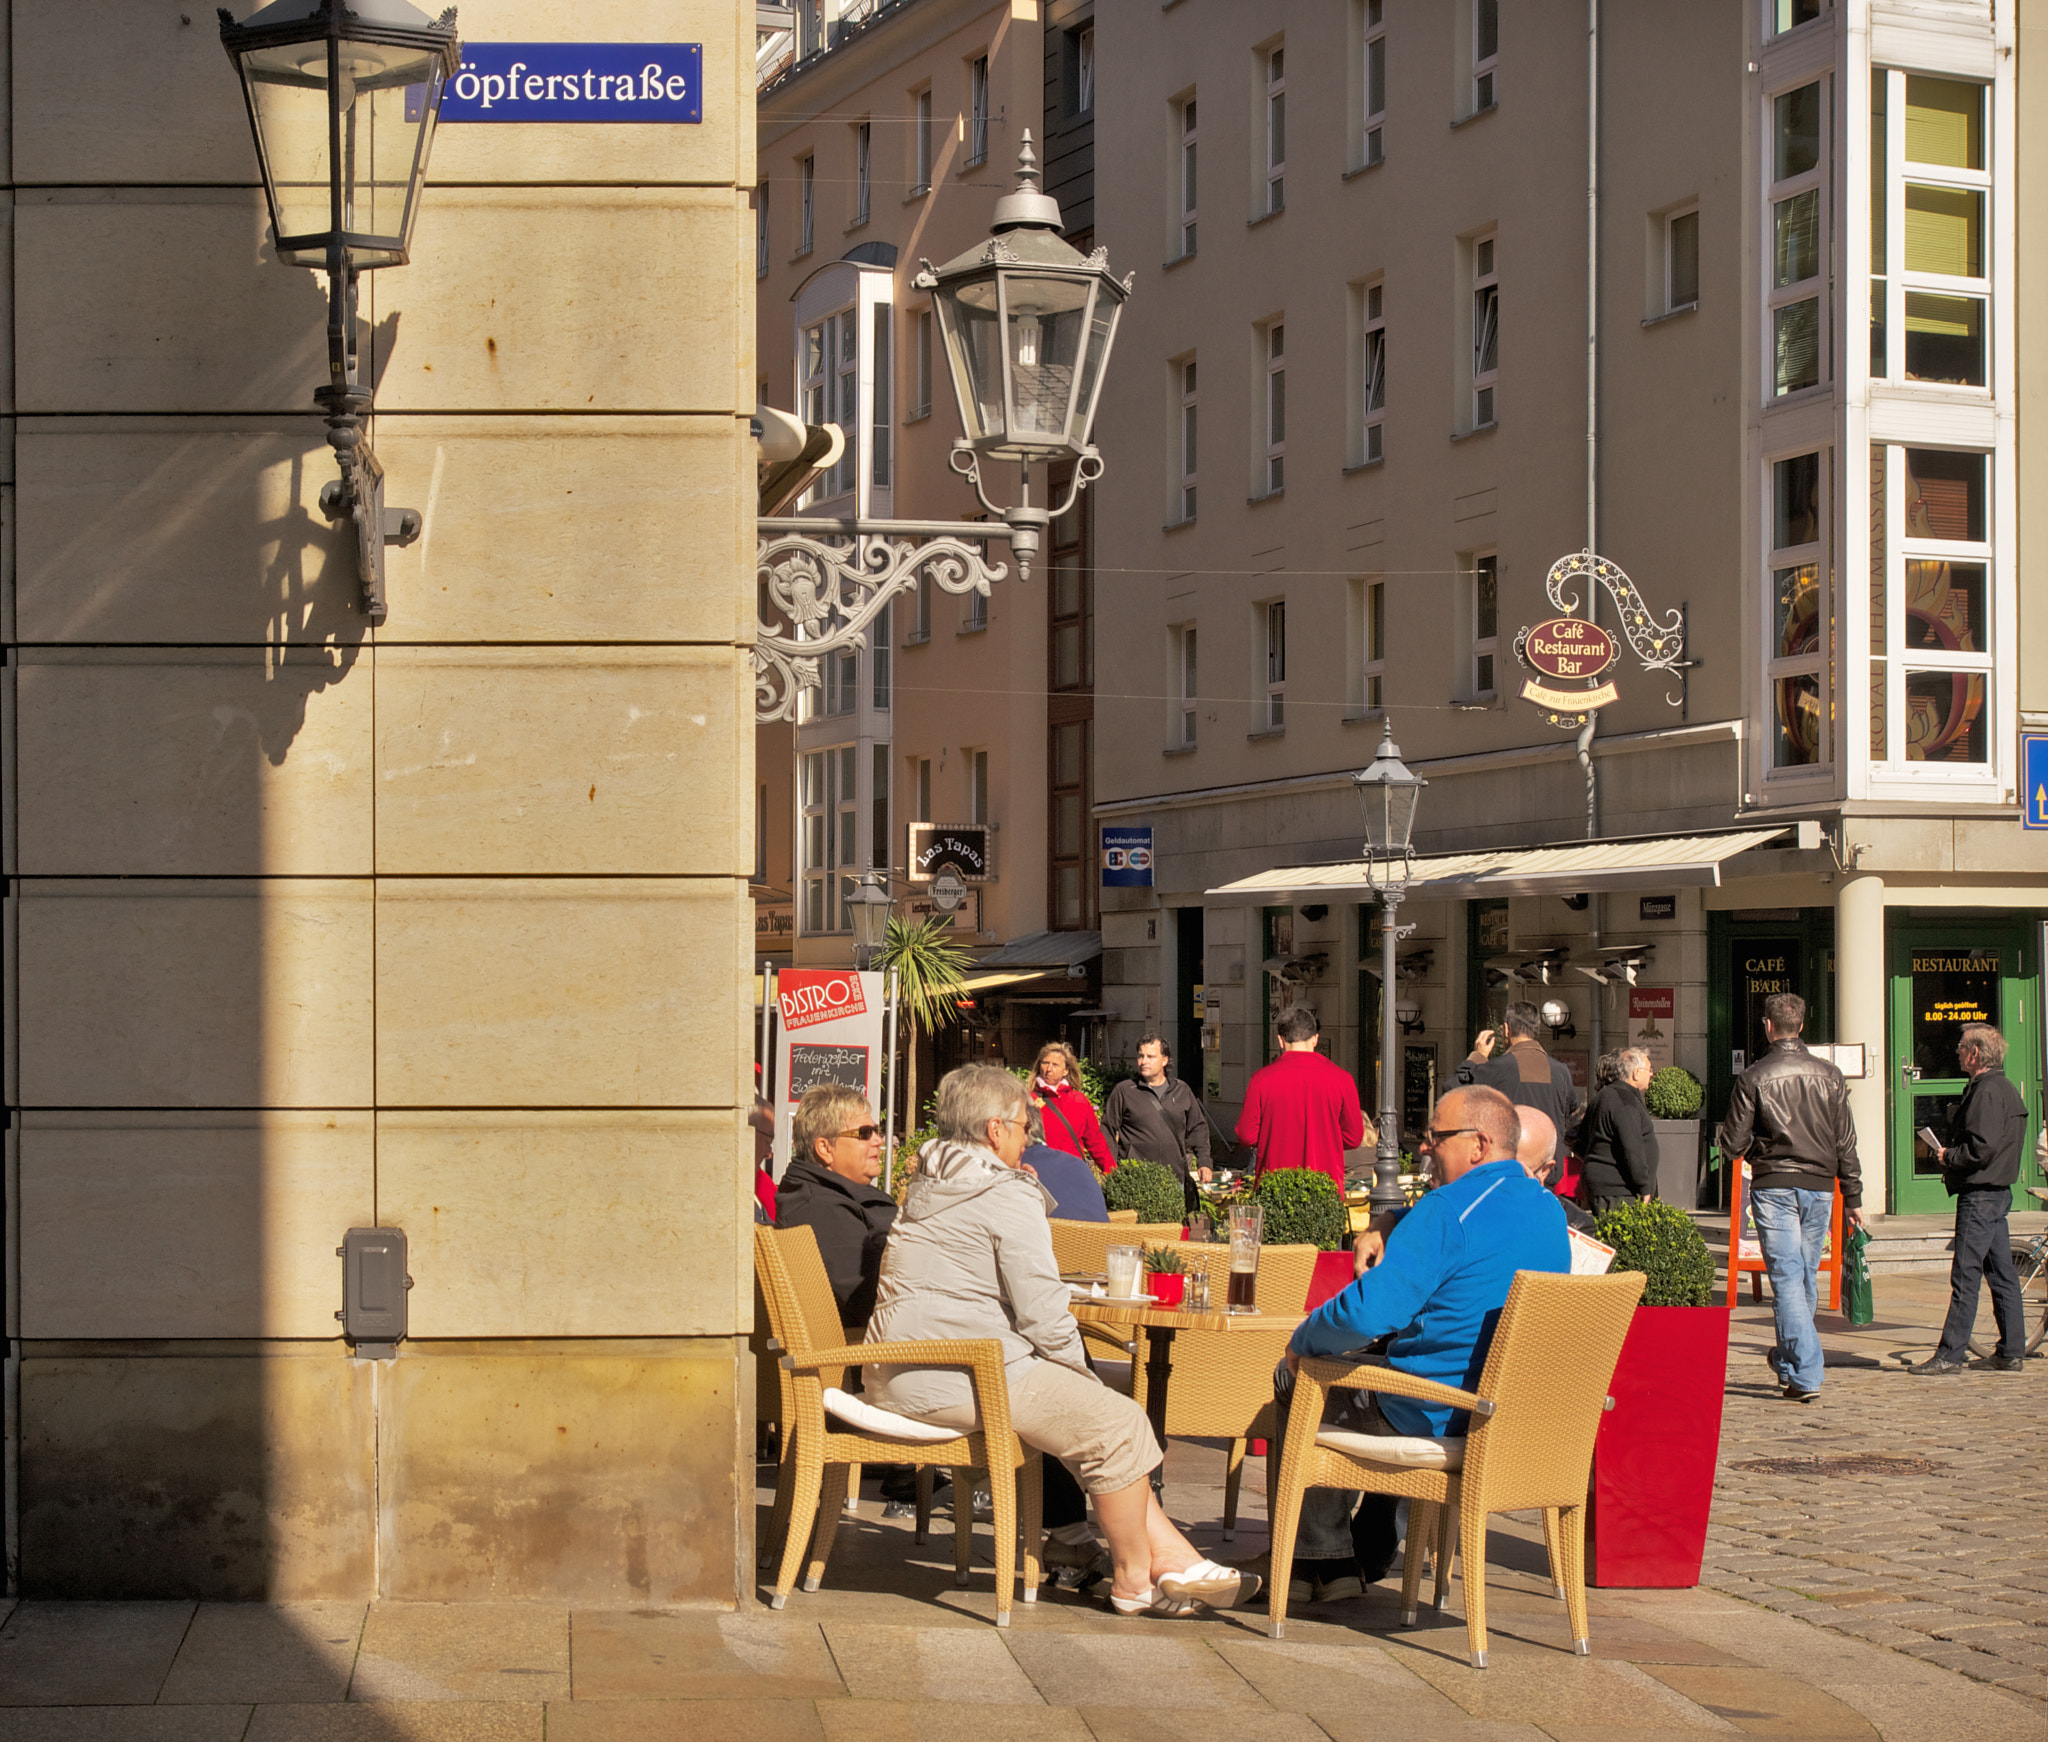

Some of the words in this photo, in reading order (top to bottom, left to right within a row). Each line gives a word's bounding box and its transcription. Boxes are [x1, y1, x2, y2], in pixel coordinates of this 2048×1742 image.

[1552, 623, 1584, 639] Café
[1534, 639, 1605, 656] Restaurant
[1557, 657, 1582, 674] Bar
[1105, 836, 1151, 845] Geldautomat
[917, 843, 943, 868] Las
[944, 838, 983, 868] Tapas
[768, 910, 793, 936] Tapa
[1745, 956, 1785, 972] CAFÉ
[1912, 958, 1998, 972] RESTAURANT
[849, 974, 863, 1002] ECKE
[1751, 980, 1782, 993] BAR
[780, 980, 850, 1017] BISTRO
[786, 1001, 865, 1029] FRAUENKIRCHE
[1925, 1012, 1943, 1021] 8.00
[1948, 1011, 1972, 1021] 24.00
[1972, 1011, 1988, 1020] Uhr
